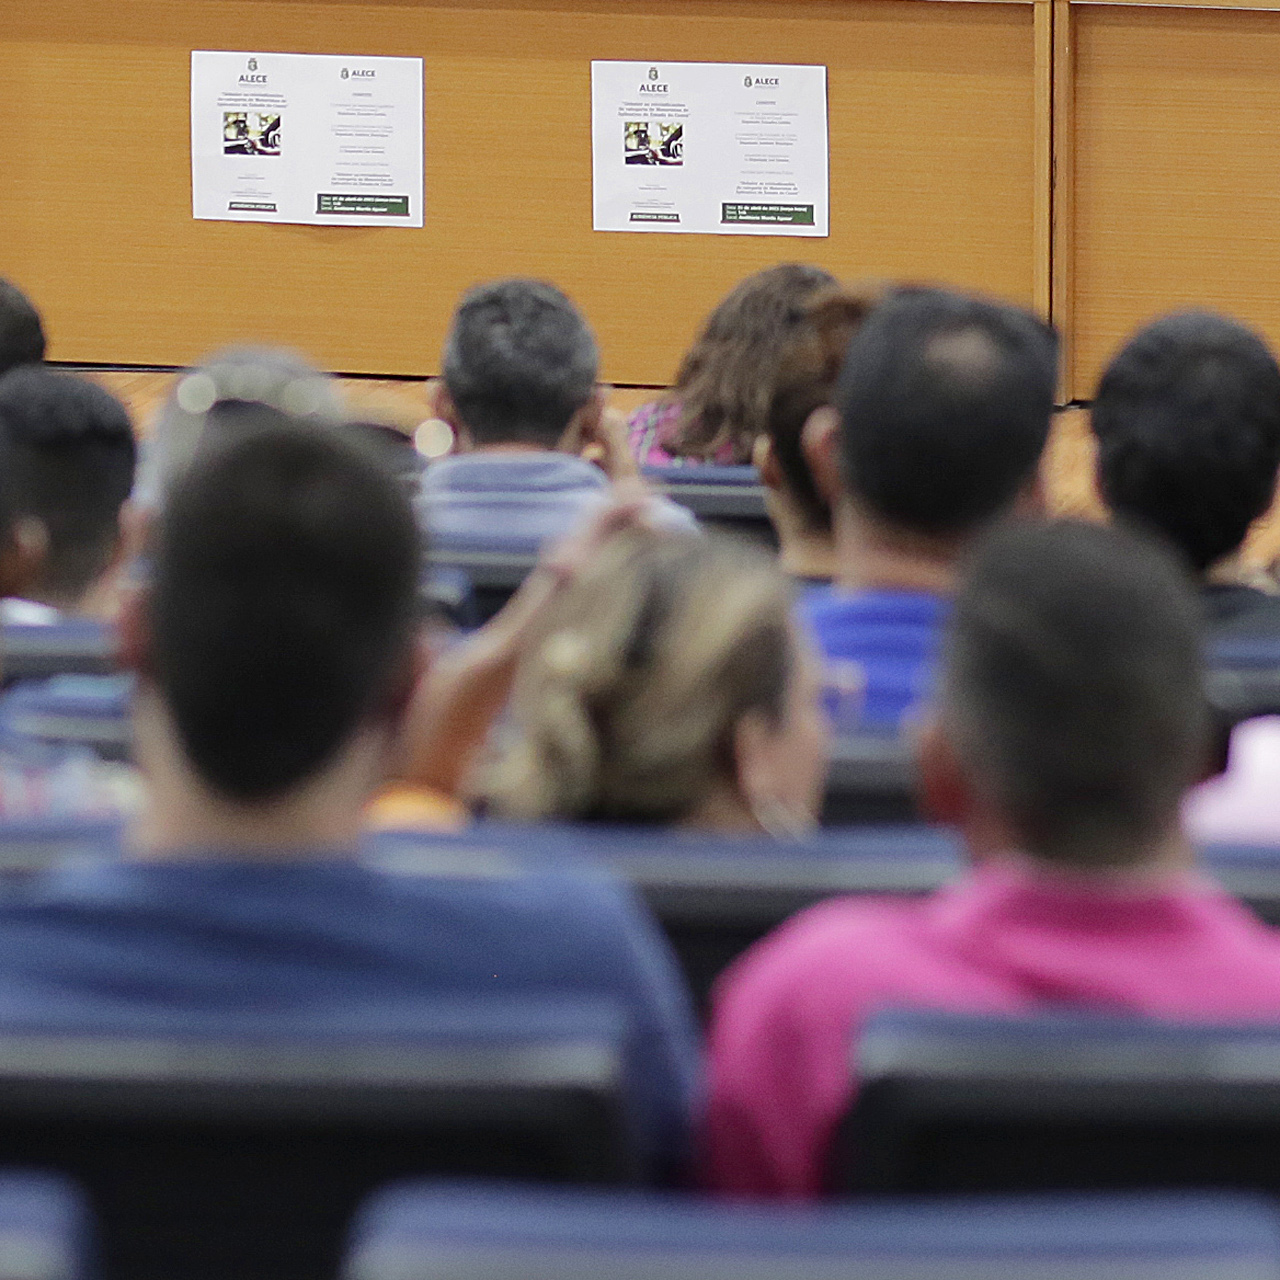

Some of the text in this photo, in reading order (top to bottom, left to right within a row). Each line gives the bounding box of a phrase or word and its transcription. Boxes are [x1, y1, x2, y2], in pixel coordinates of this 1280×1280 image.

[352, 70, 376, 78] ALECE
[239, 75, 267, 83] ALECE
[639, 84, 668, 93] ALECE
